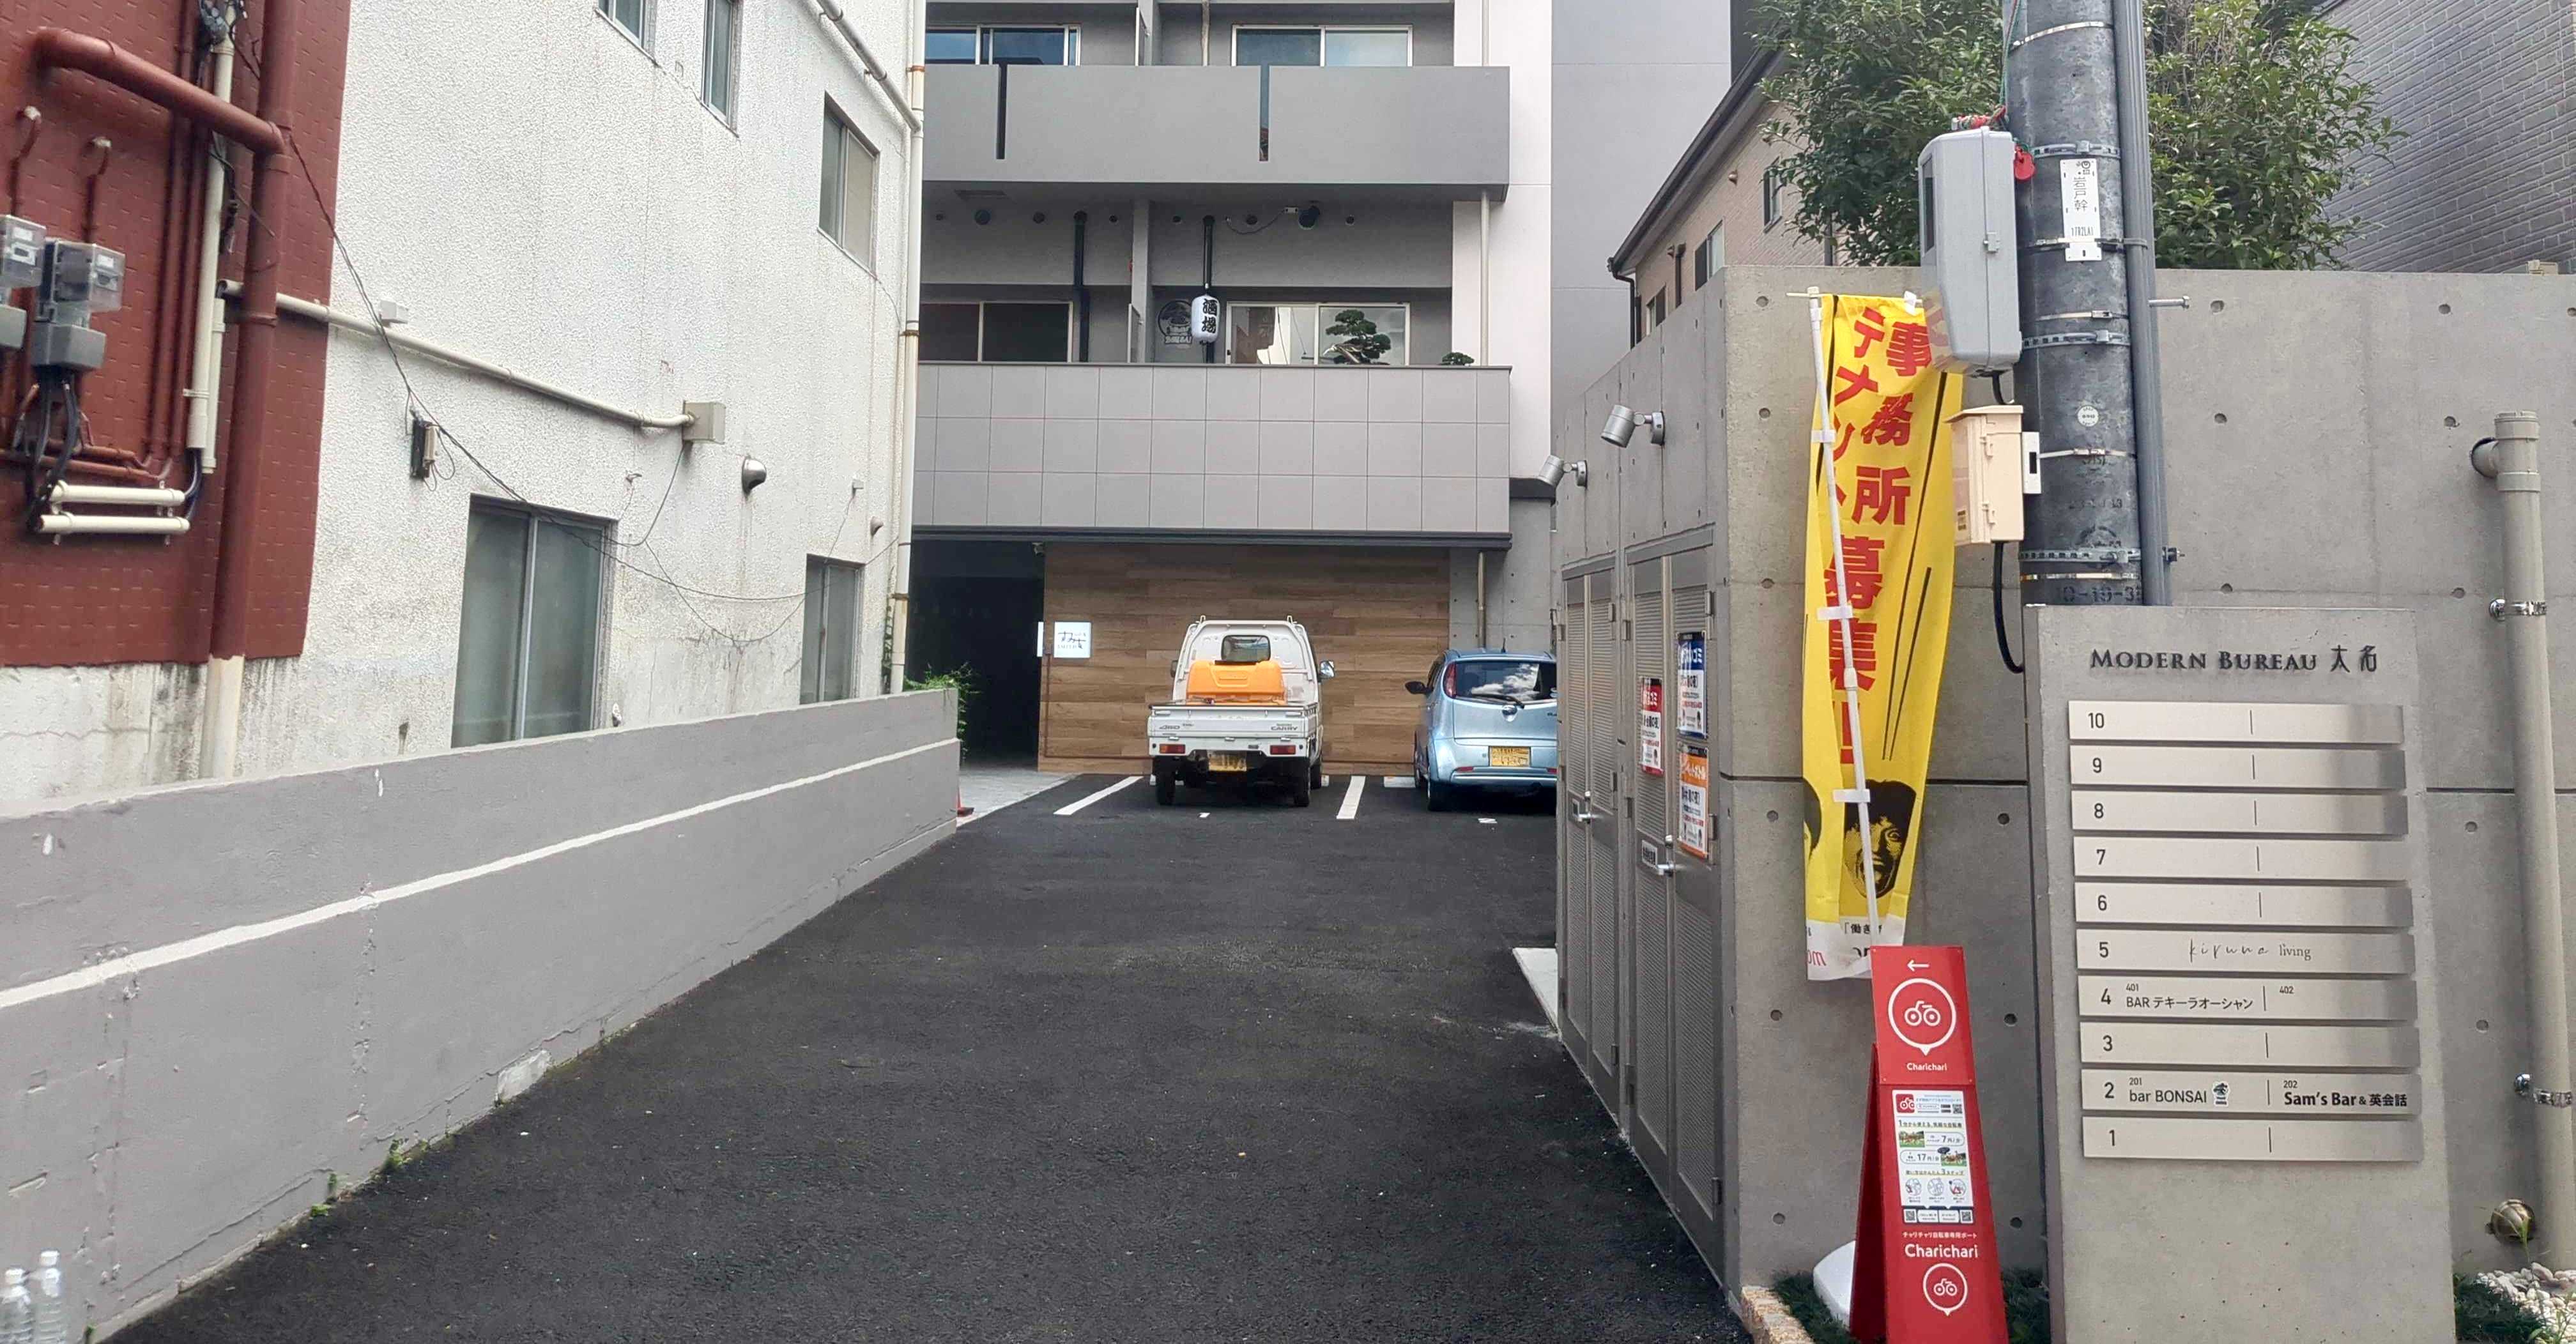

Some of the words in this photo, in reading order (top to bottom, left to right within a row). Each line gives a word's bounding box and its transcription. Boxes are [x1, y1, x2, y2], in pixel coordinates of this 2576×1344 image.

[1201, 298, 1218, 333] 酒場
[2087, 712, 2104, 729] 10
[2092, 758, 2102, 773] 9
[2094, 803, 2104, 819] 8
[2096, 849, 2106, 864] 7
[2097, 895, 2107, 911] 6
[2099, 942, 2109, 958] 5
[2279, 944, 2312, 961] living
[2126, 983, 2139, 991] 401
[2279, 986, 2294, 994] 402
[2101, 988, 2111, 1005] 4
[2126, 997, 2150, 1008] BAR
[2153, 997, 2253, 1009] テキーラオーシャン
[2103, 1035, 2113, 1051] 3
[1906, 1062, 1947, 1071] Charichari
[2129, 1077, 2142, 1085] 201
[2283, 1080, 2297, 1088] 202
[2104, 1083, 2115, 1099] 2
[2129, 1090, 2151, 1103] bar
[2156, 1090, 2207, 1104] BONSAI
[2331, 1093, 2356, 1106] Bar
[2358, 1097, 2366, 1106] &
[2369, 1094, 2407, 1107] 英会話
[2108, 1129, 2115, 1146] 1
[1905, 1244, 1978, 1258] Charichari
